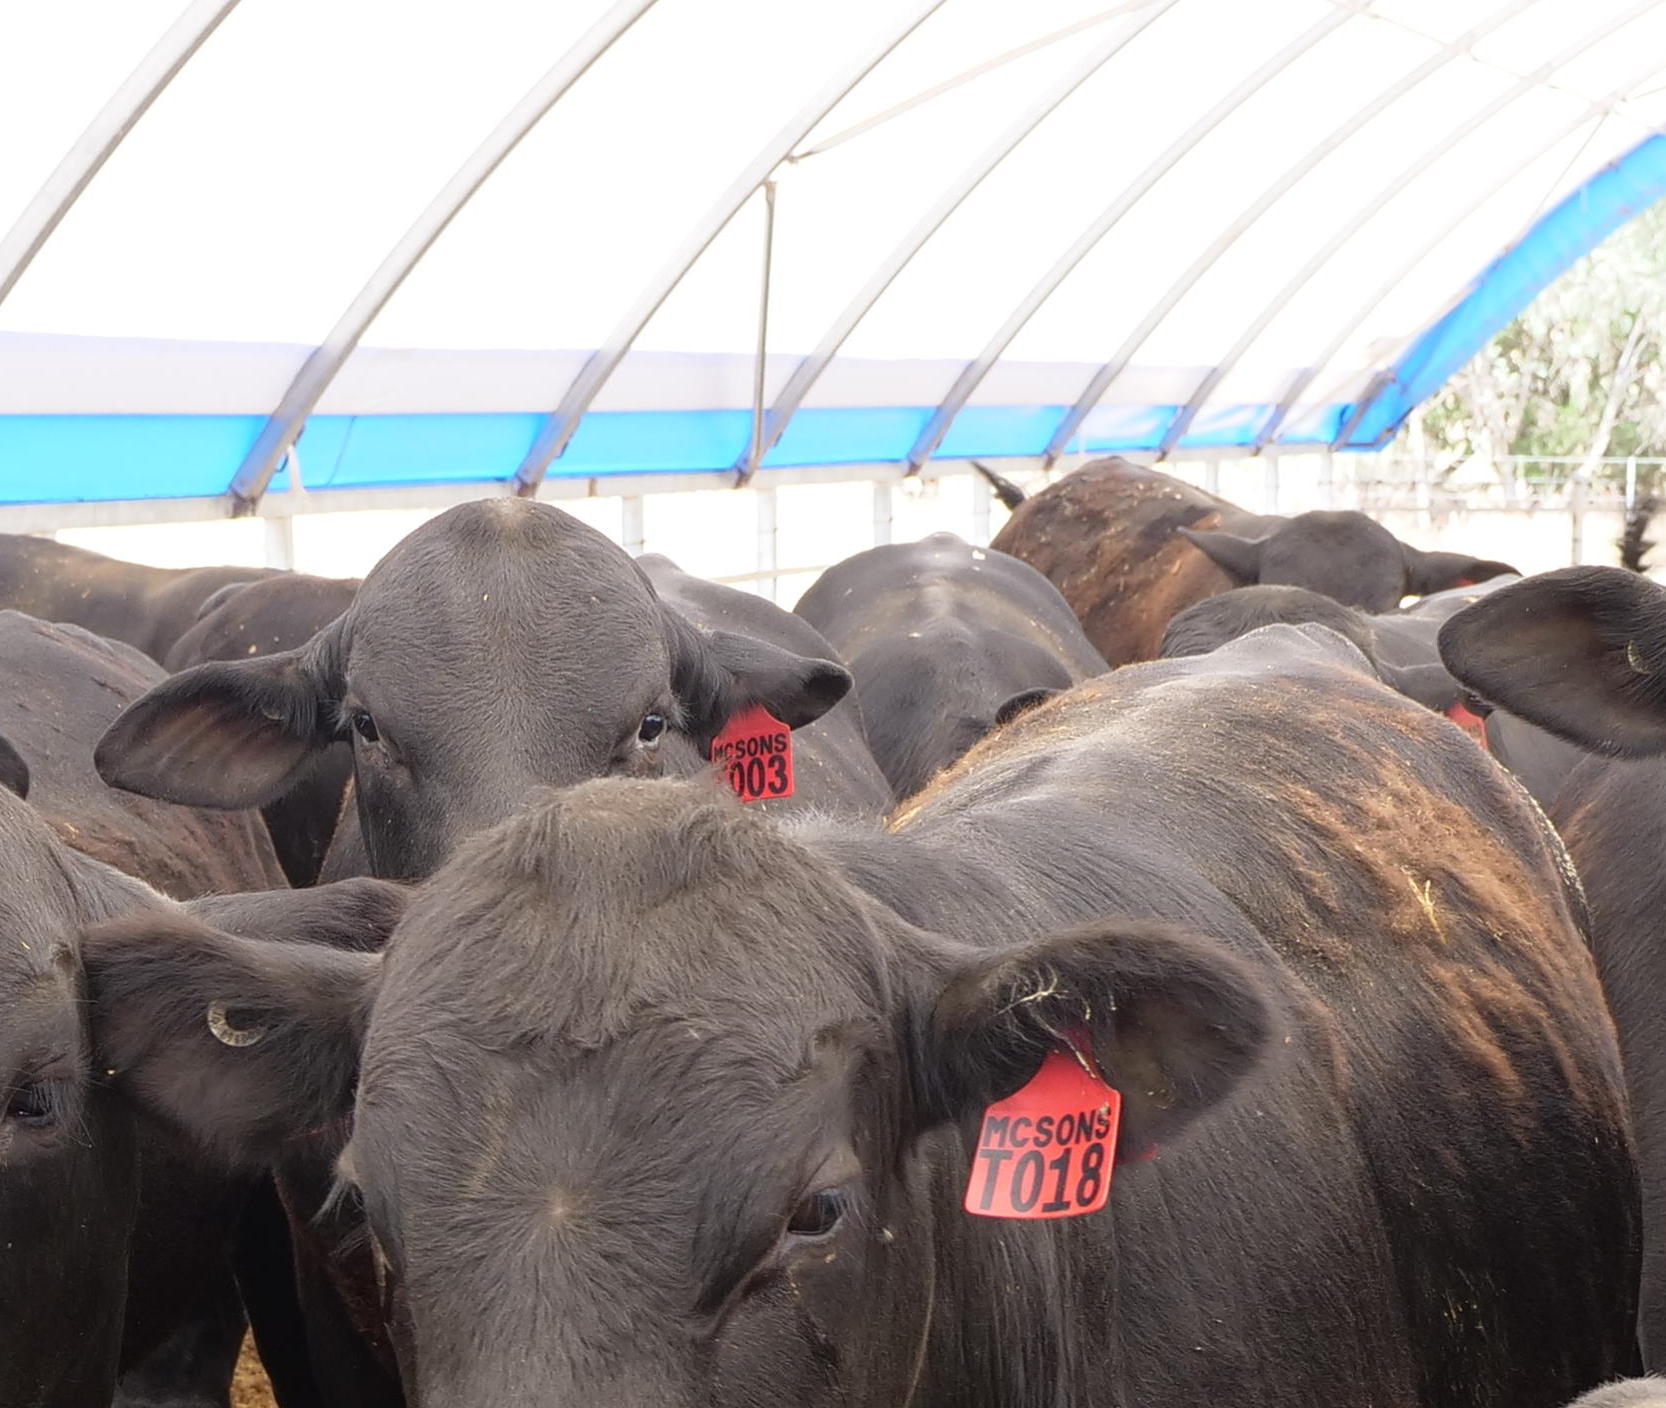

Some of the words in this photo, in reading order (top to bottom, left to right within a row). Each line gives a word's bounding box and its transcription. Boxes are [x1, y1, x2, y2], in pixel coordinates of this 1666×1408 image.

[714, 733, 788, 762] MCSONS
[719, 755, 788, 797] 003
[983, 1106, 1111, 1148] MCSONS
[980, 1143, 1105, 1213] T018
